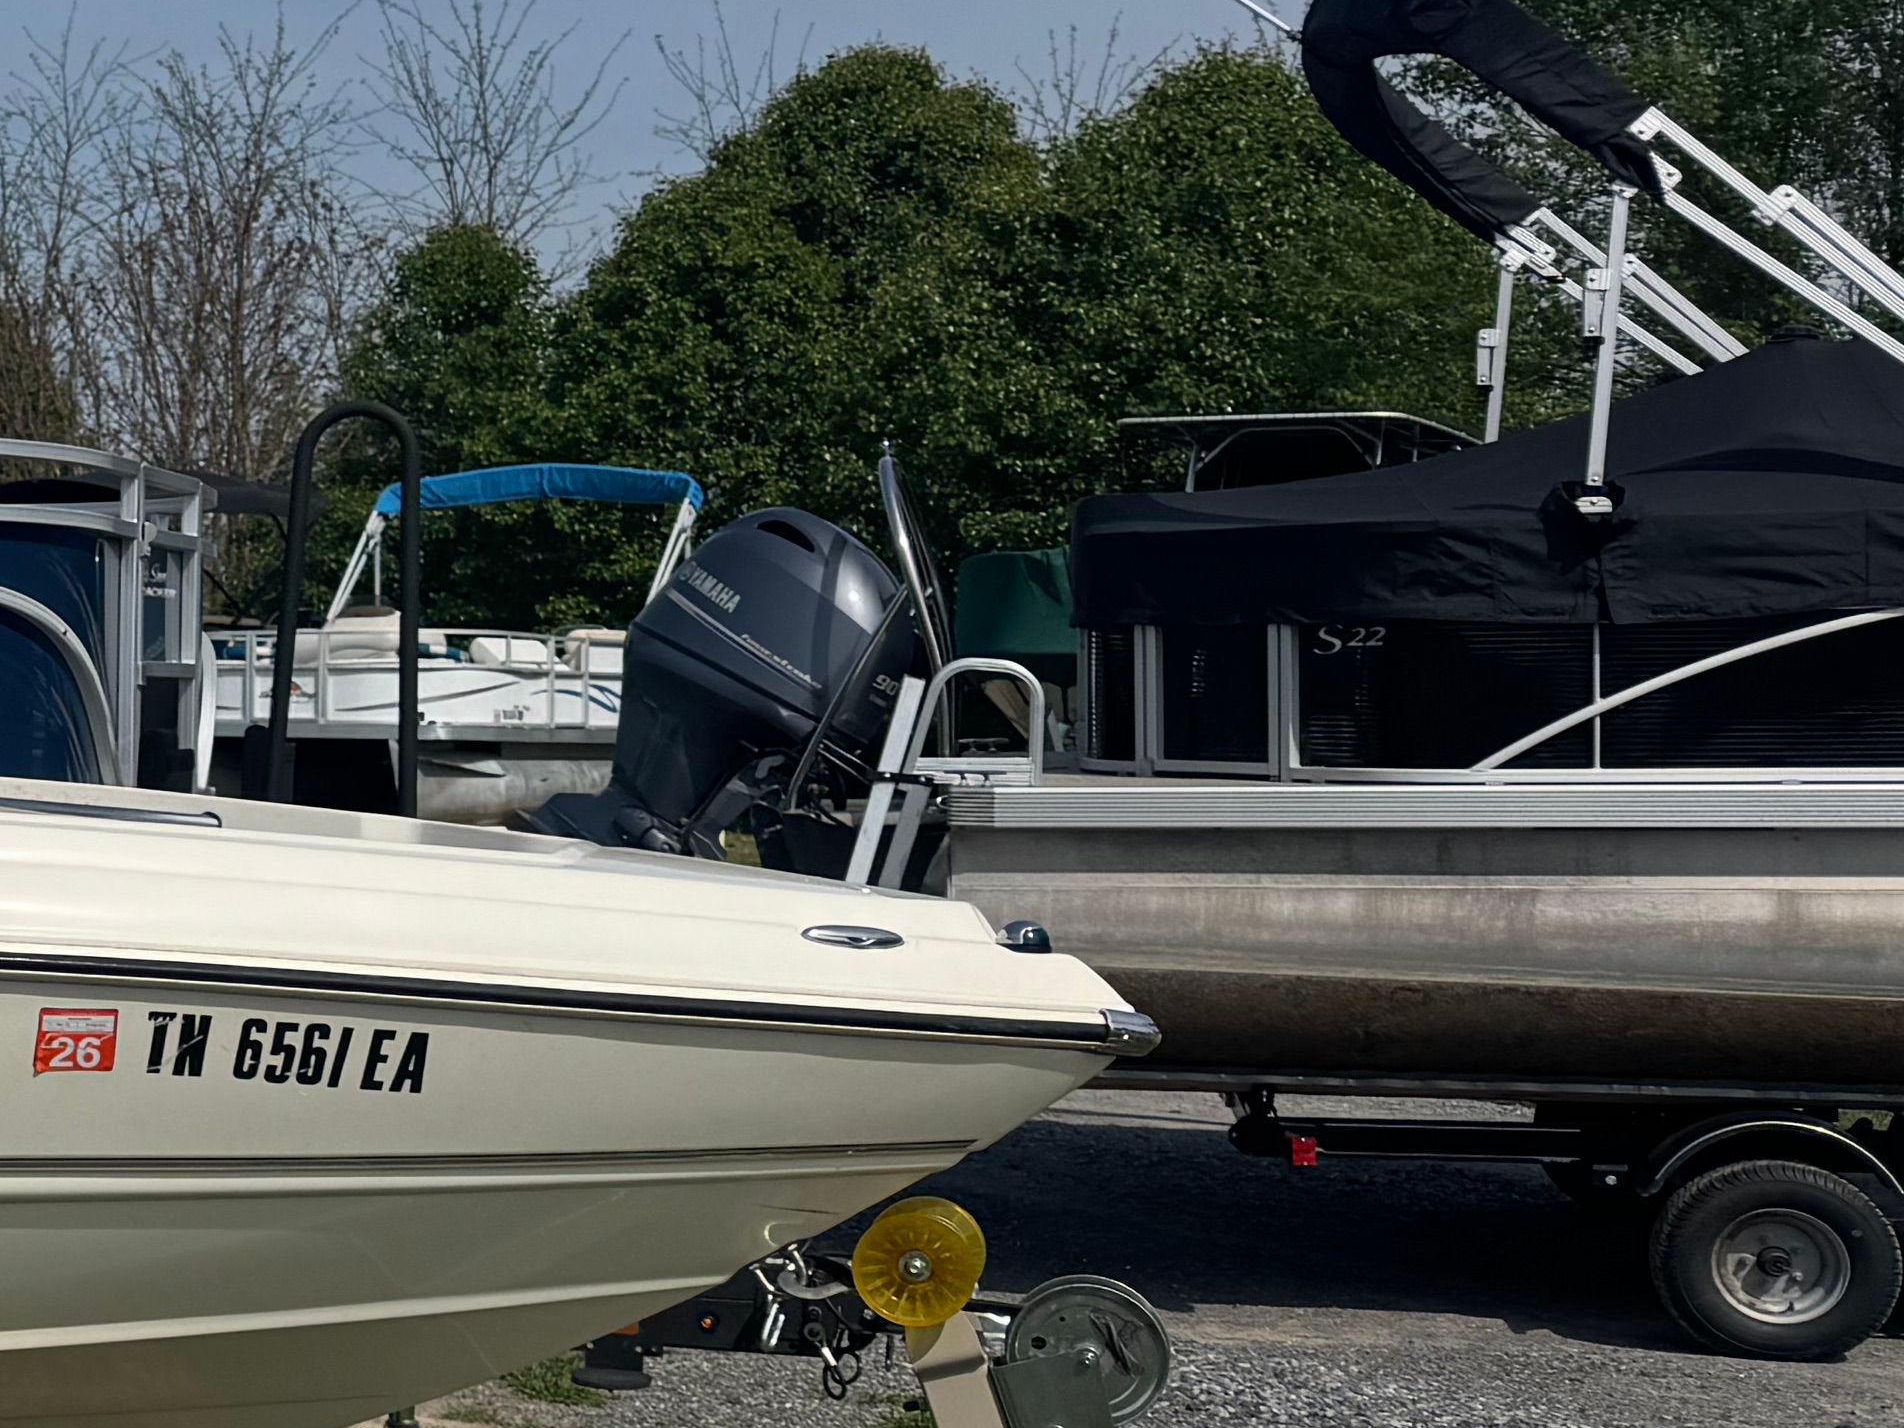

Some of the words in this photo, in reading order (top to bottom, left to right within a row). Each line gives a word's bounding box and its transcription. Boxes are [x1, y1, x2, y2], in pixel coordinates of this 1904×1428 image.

[686, 563, 742, 614] YAMAHA
[872, 674, 901, 696] 90
[48, 1036, 101, 1069] 26
[146, 1010, 213, 1077] TN
[232, 1017, 355, 1088] 6561
[359, 1028, 430, 1094] EA
